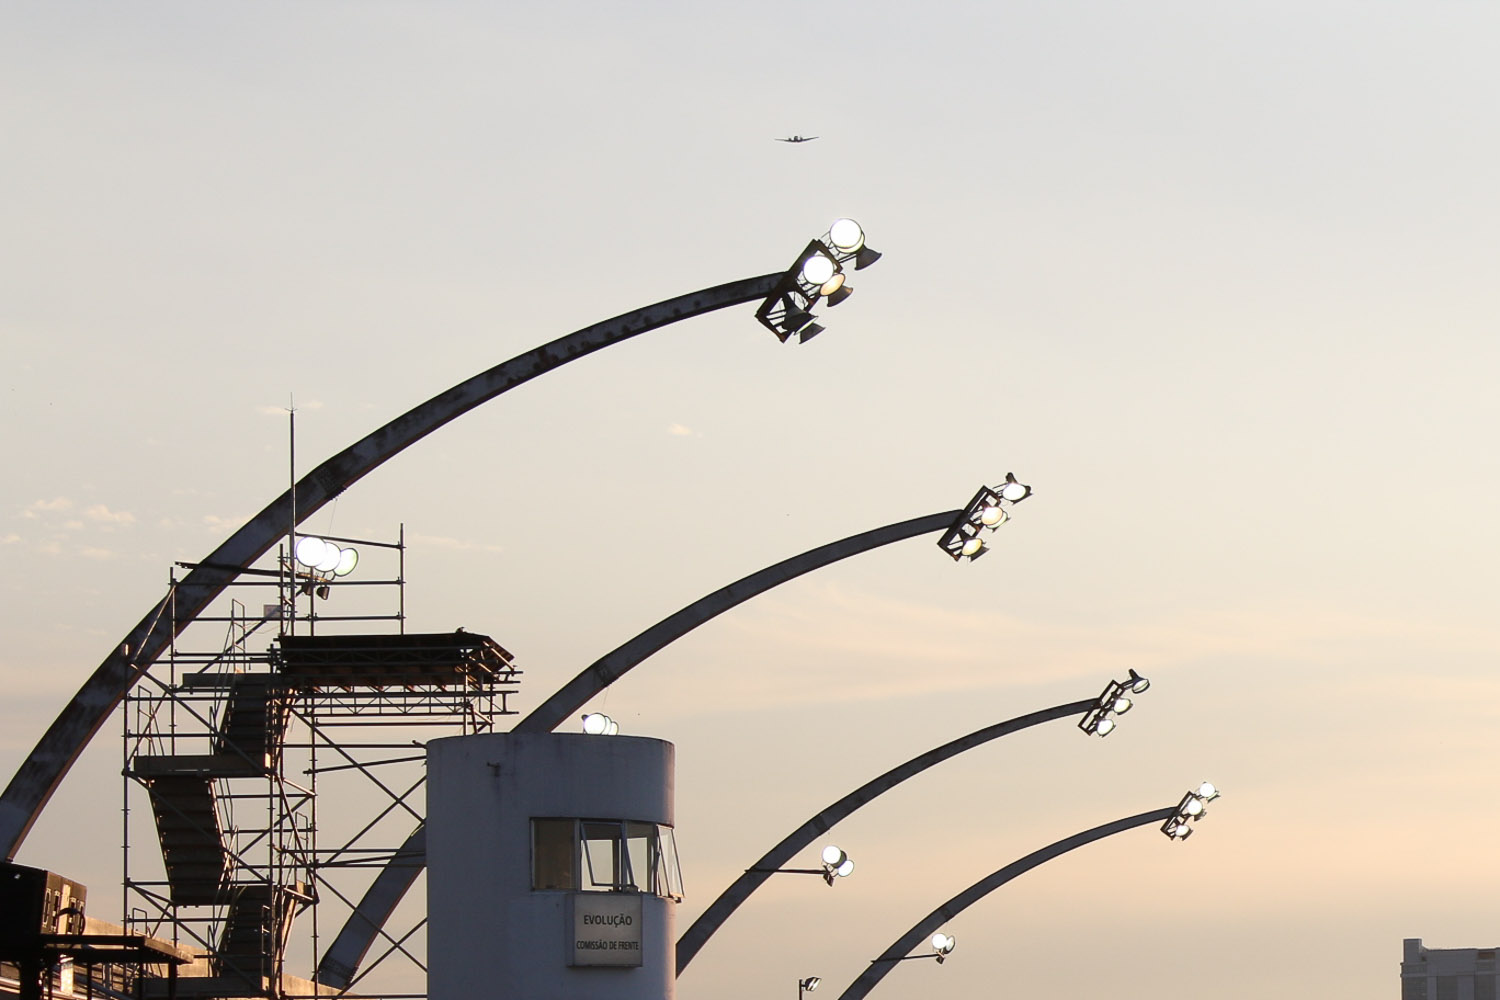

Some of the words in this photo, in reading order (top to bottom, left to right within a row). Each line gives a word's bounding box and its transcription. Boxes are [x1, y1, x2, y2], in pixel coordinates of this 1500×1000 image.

[583, 913, 633, 928] EVOLUÇÃO
[576, 939, 608, 950] COMISSÃO
[609, 941, 617, 950] DE
[618, 941, 639, 951] FRENTE
